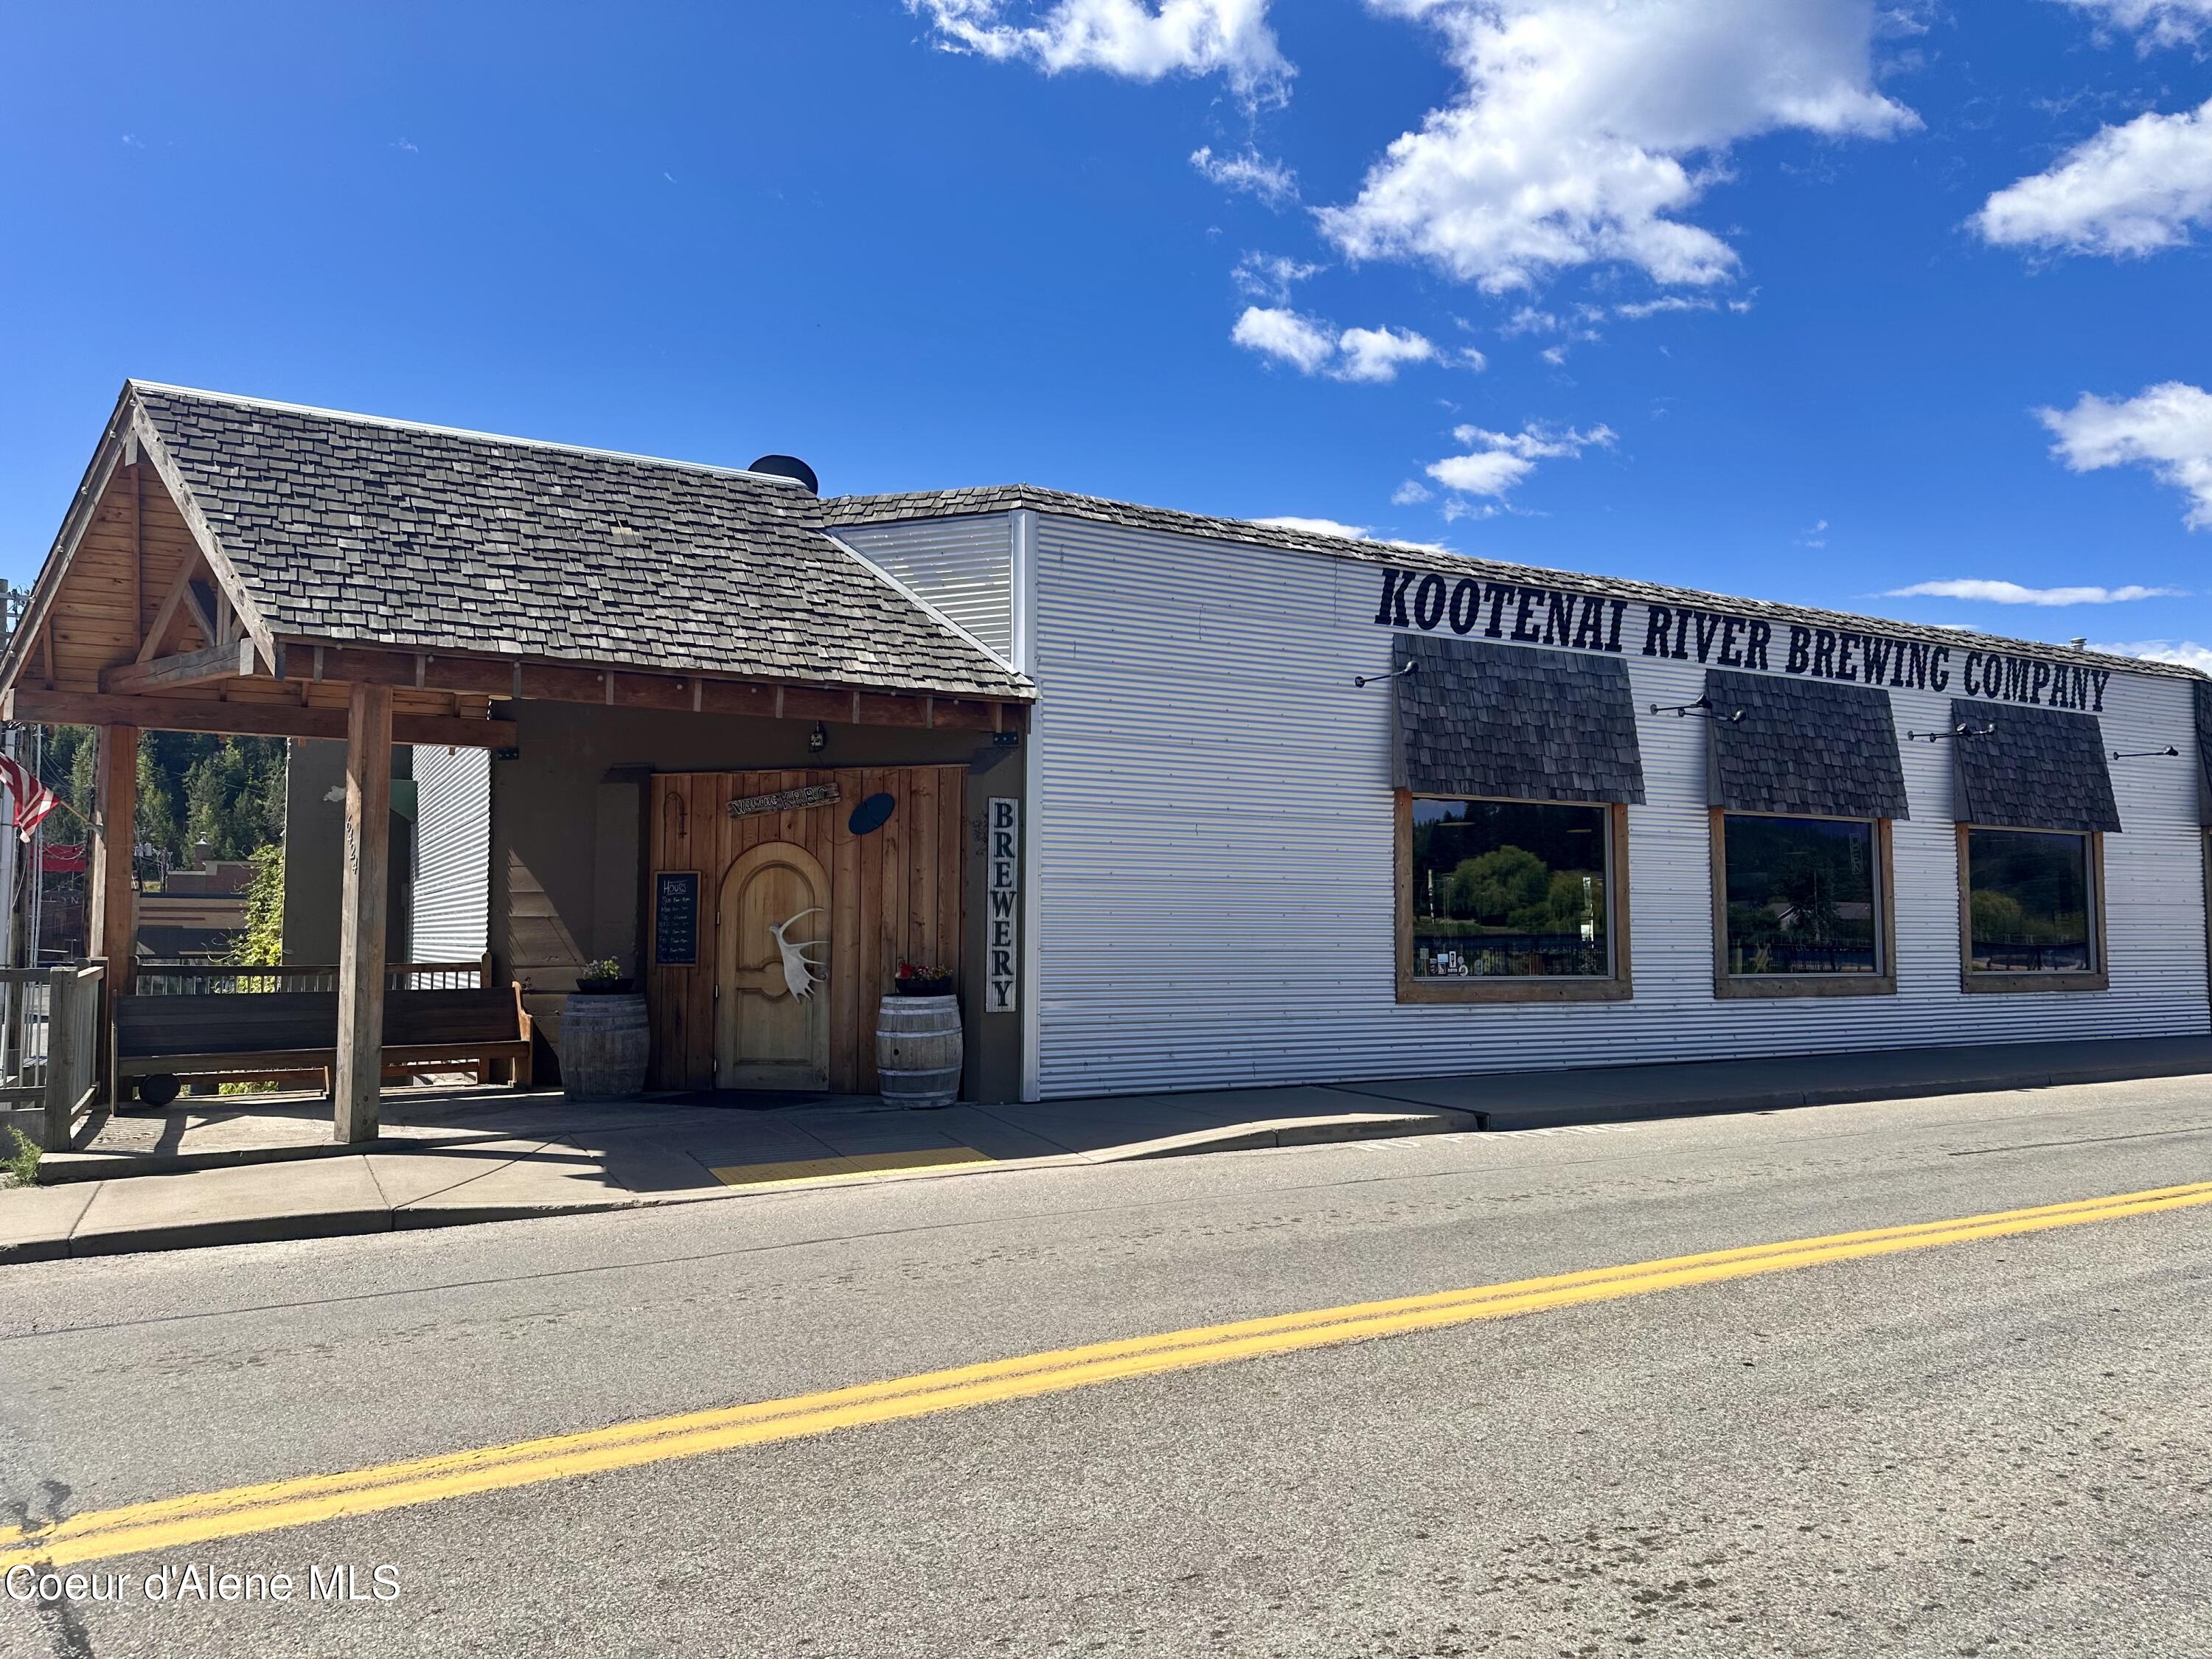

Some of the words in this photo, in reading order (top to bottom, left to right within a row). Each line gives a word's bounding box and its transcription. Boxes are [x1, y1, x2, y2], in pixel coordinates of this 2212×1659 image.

[1374, 567, 1627, 653] KOOTENAI
[1642, 605, 1771, 670] RIVER
[1785, 625, 1950, 692] BREWING
[1964, 651, 2110, 712] COMPANY
[346, 814, 358, 874] 6424
[779, 786, 830, 810] KRBC
[990, 801, 1017, 1007] BREWERY
